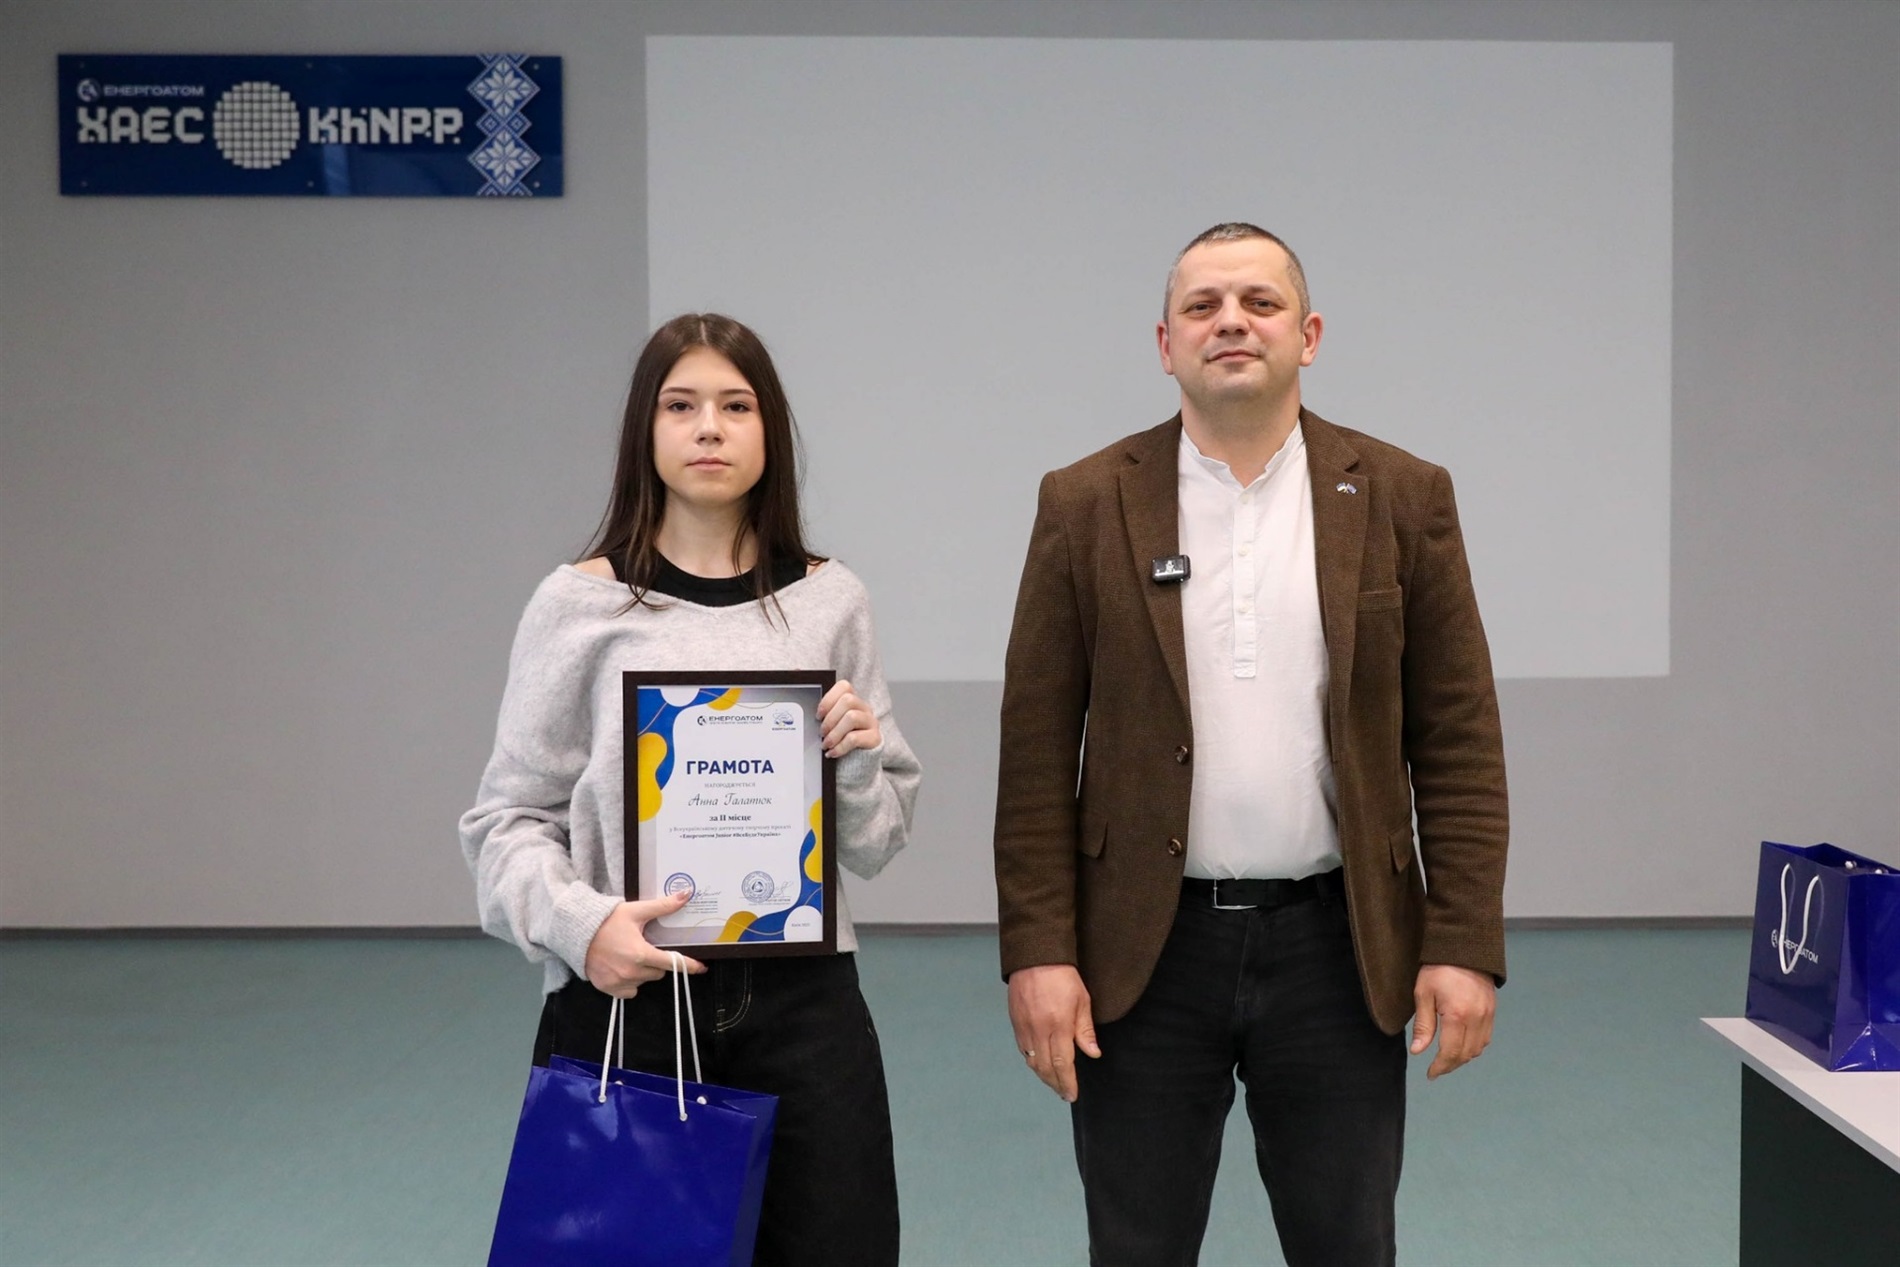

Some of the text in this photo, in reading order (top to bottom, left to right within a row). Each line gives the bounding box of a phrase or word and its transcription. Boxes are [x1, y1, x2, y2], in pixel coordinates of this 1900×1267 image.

[103, 84, 204, 97] ЕНЕРГОАТОМ
[77, 107, 205, 144] ХАЕС
[686, 760, 775, 775] ГРАМОТА
[688, 793, 718, 806] Анна
